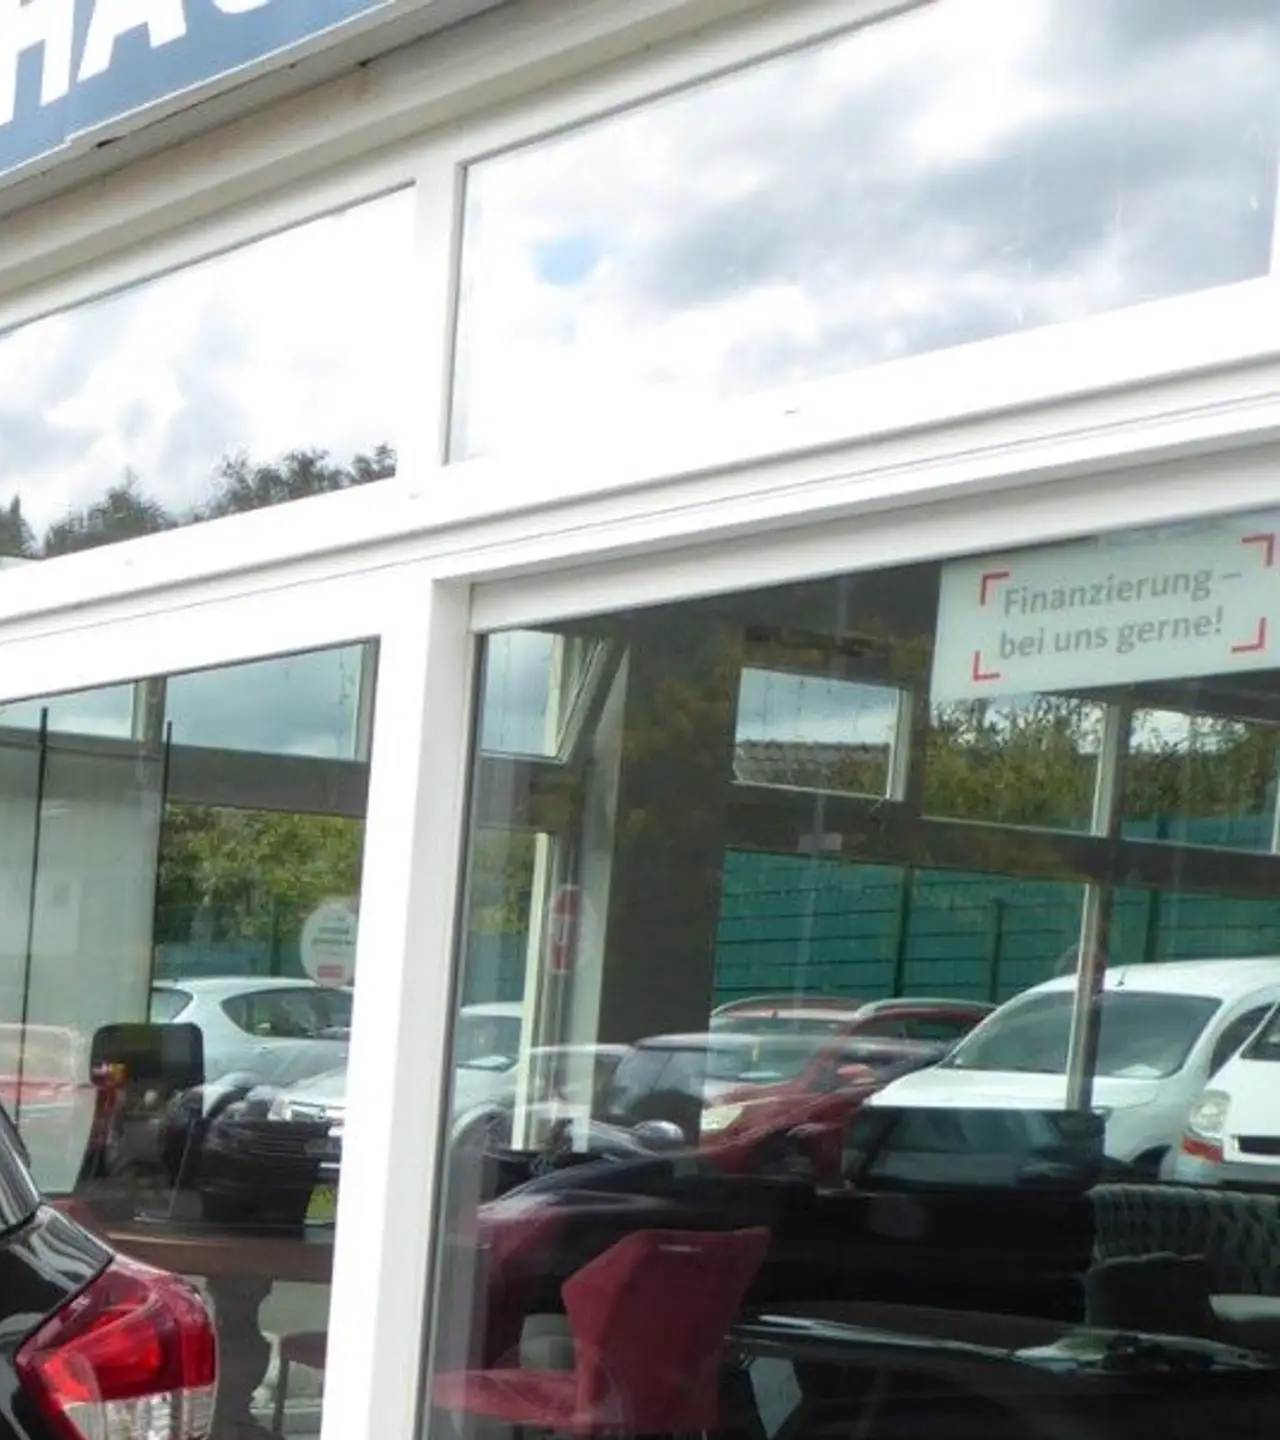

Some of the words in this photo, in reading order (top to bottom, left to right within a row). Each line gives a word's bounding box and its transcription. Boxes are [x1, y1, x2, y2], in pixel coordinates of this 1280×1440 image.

[1002, 568, 1213, 618] Finanzierung
[1000, 627, 1045, 660] bei
[1053, 624, 1108, 652] uns
[1116, 605, 1224, 654] gerne!
